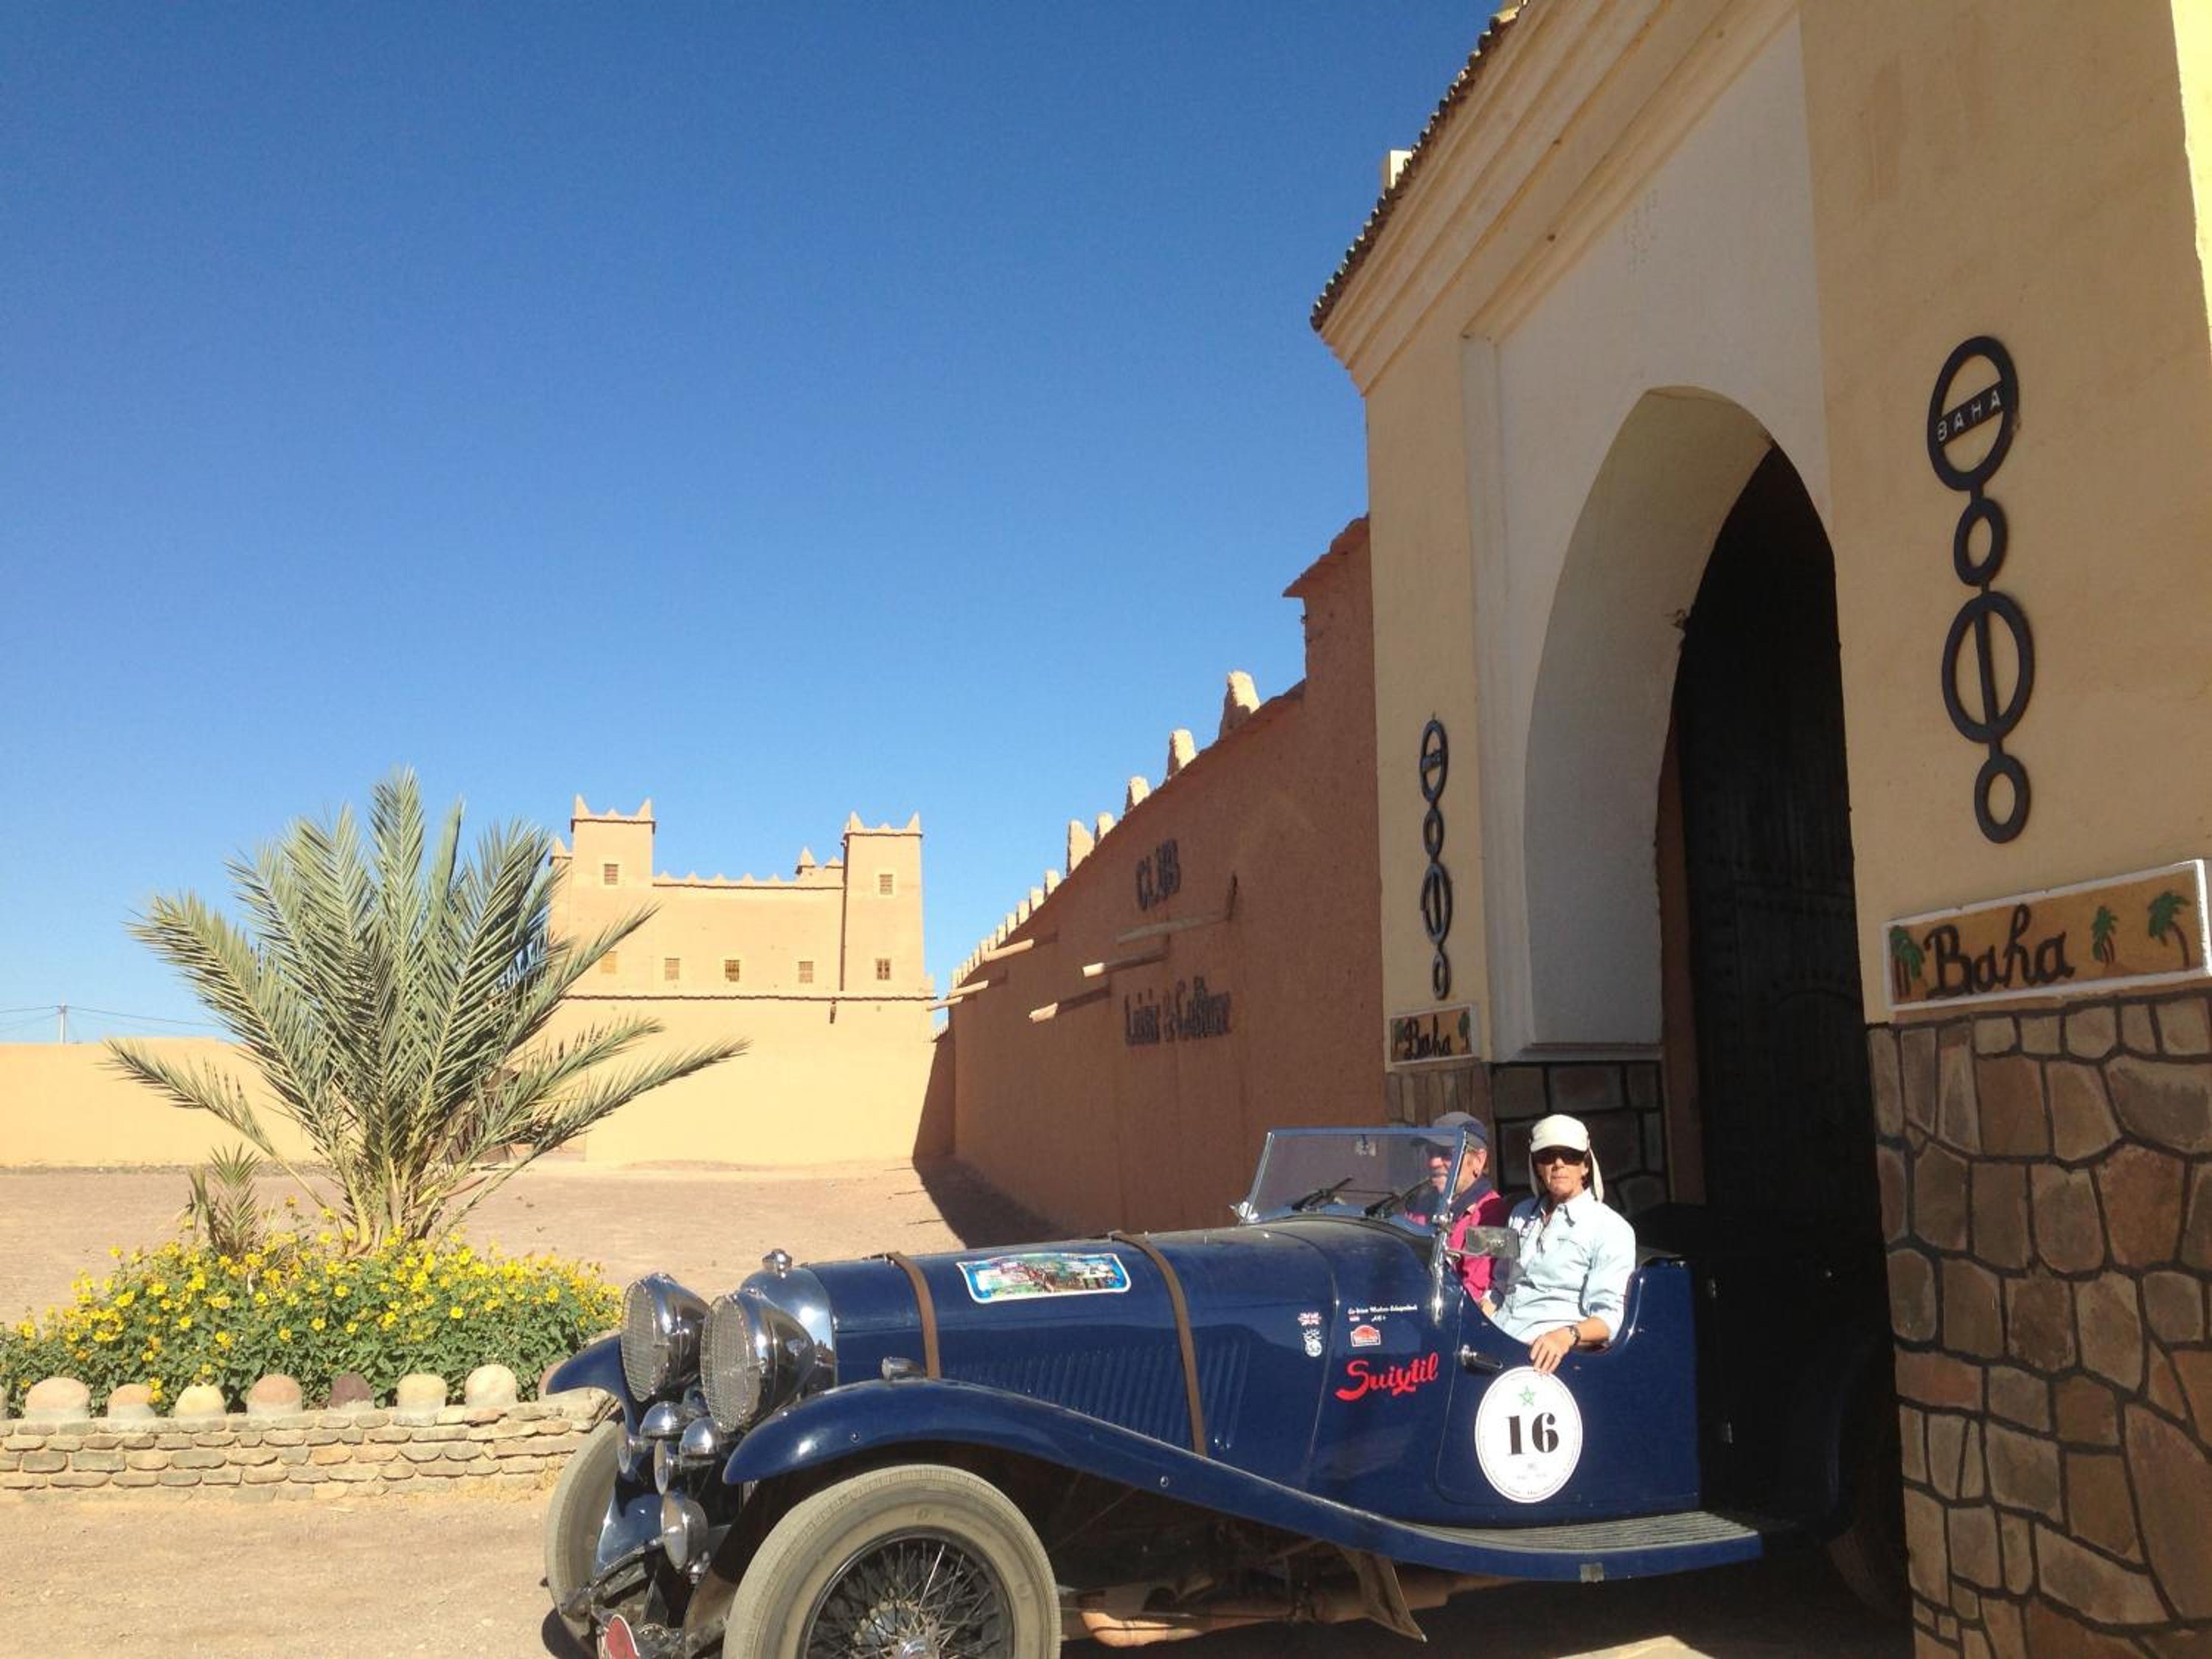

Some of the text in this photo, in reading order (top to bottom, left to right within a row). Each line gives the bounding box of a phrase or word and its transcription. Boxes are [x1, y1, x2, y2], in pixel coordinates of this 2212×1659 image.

[1937, 390, 2002, 442] BAHA
[1923, 903, 2076, 1000] Baha
[1403, 1015, 1452, 1060] Baha
[1334, 1352, 1439, 1402] Suixtil
[1506, 1412, 1559, 1456] 16
